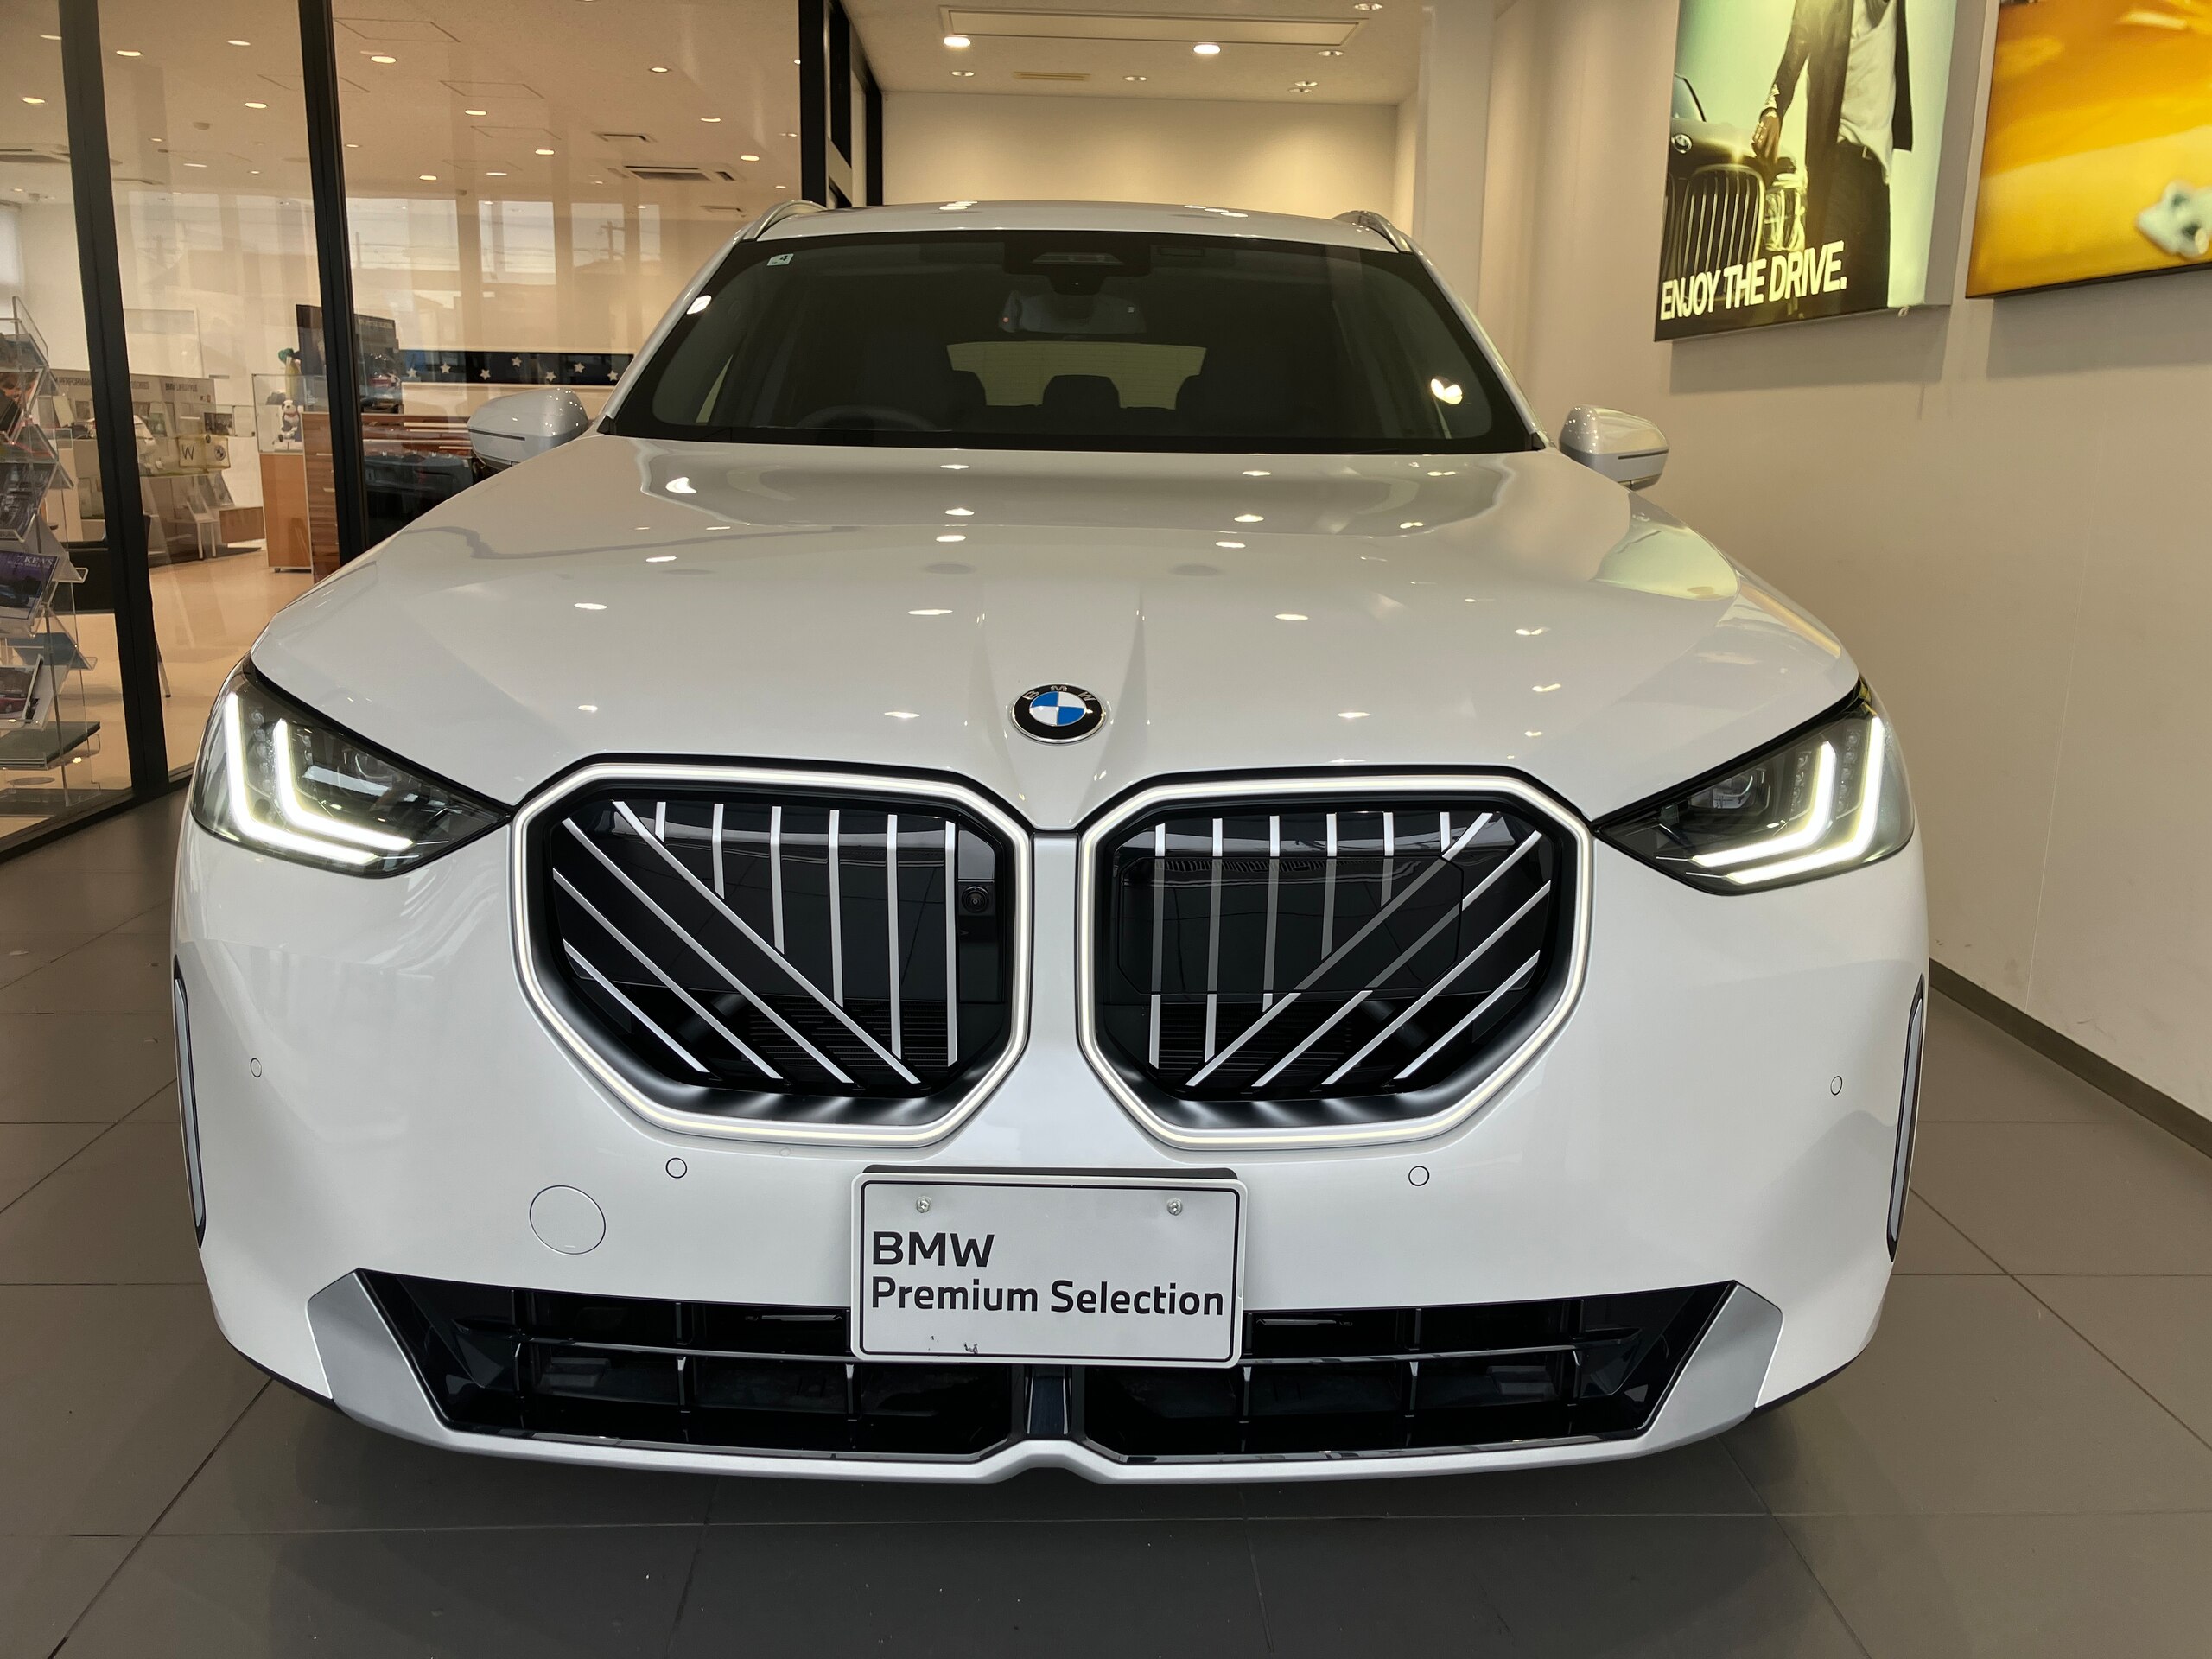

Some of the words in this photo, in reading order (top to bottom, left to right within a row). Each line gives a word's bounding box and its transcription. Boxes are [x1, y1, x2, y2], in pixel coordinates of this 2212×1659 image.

[1660, 269, 1721, 321] ENJOY
[1723, 258, 1767, 309] THE
[1769, 240, 1847, 302] DRIVE.
[1022, 685, 1096, 702] BMW
[873, 1231, 995, 1268] BMW
[872, 1276, 1039, 1312] Premium
[1051, 1280, 1224, 1316] Selection
